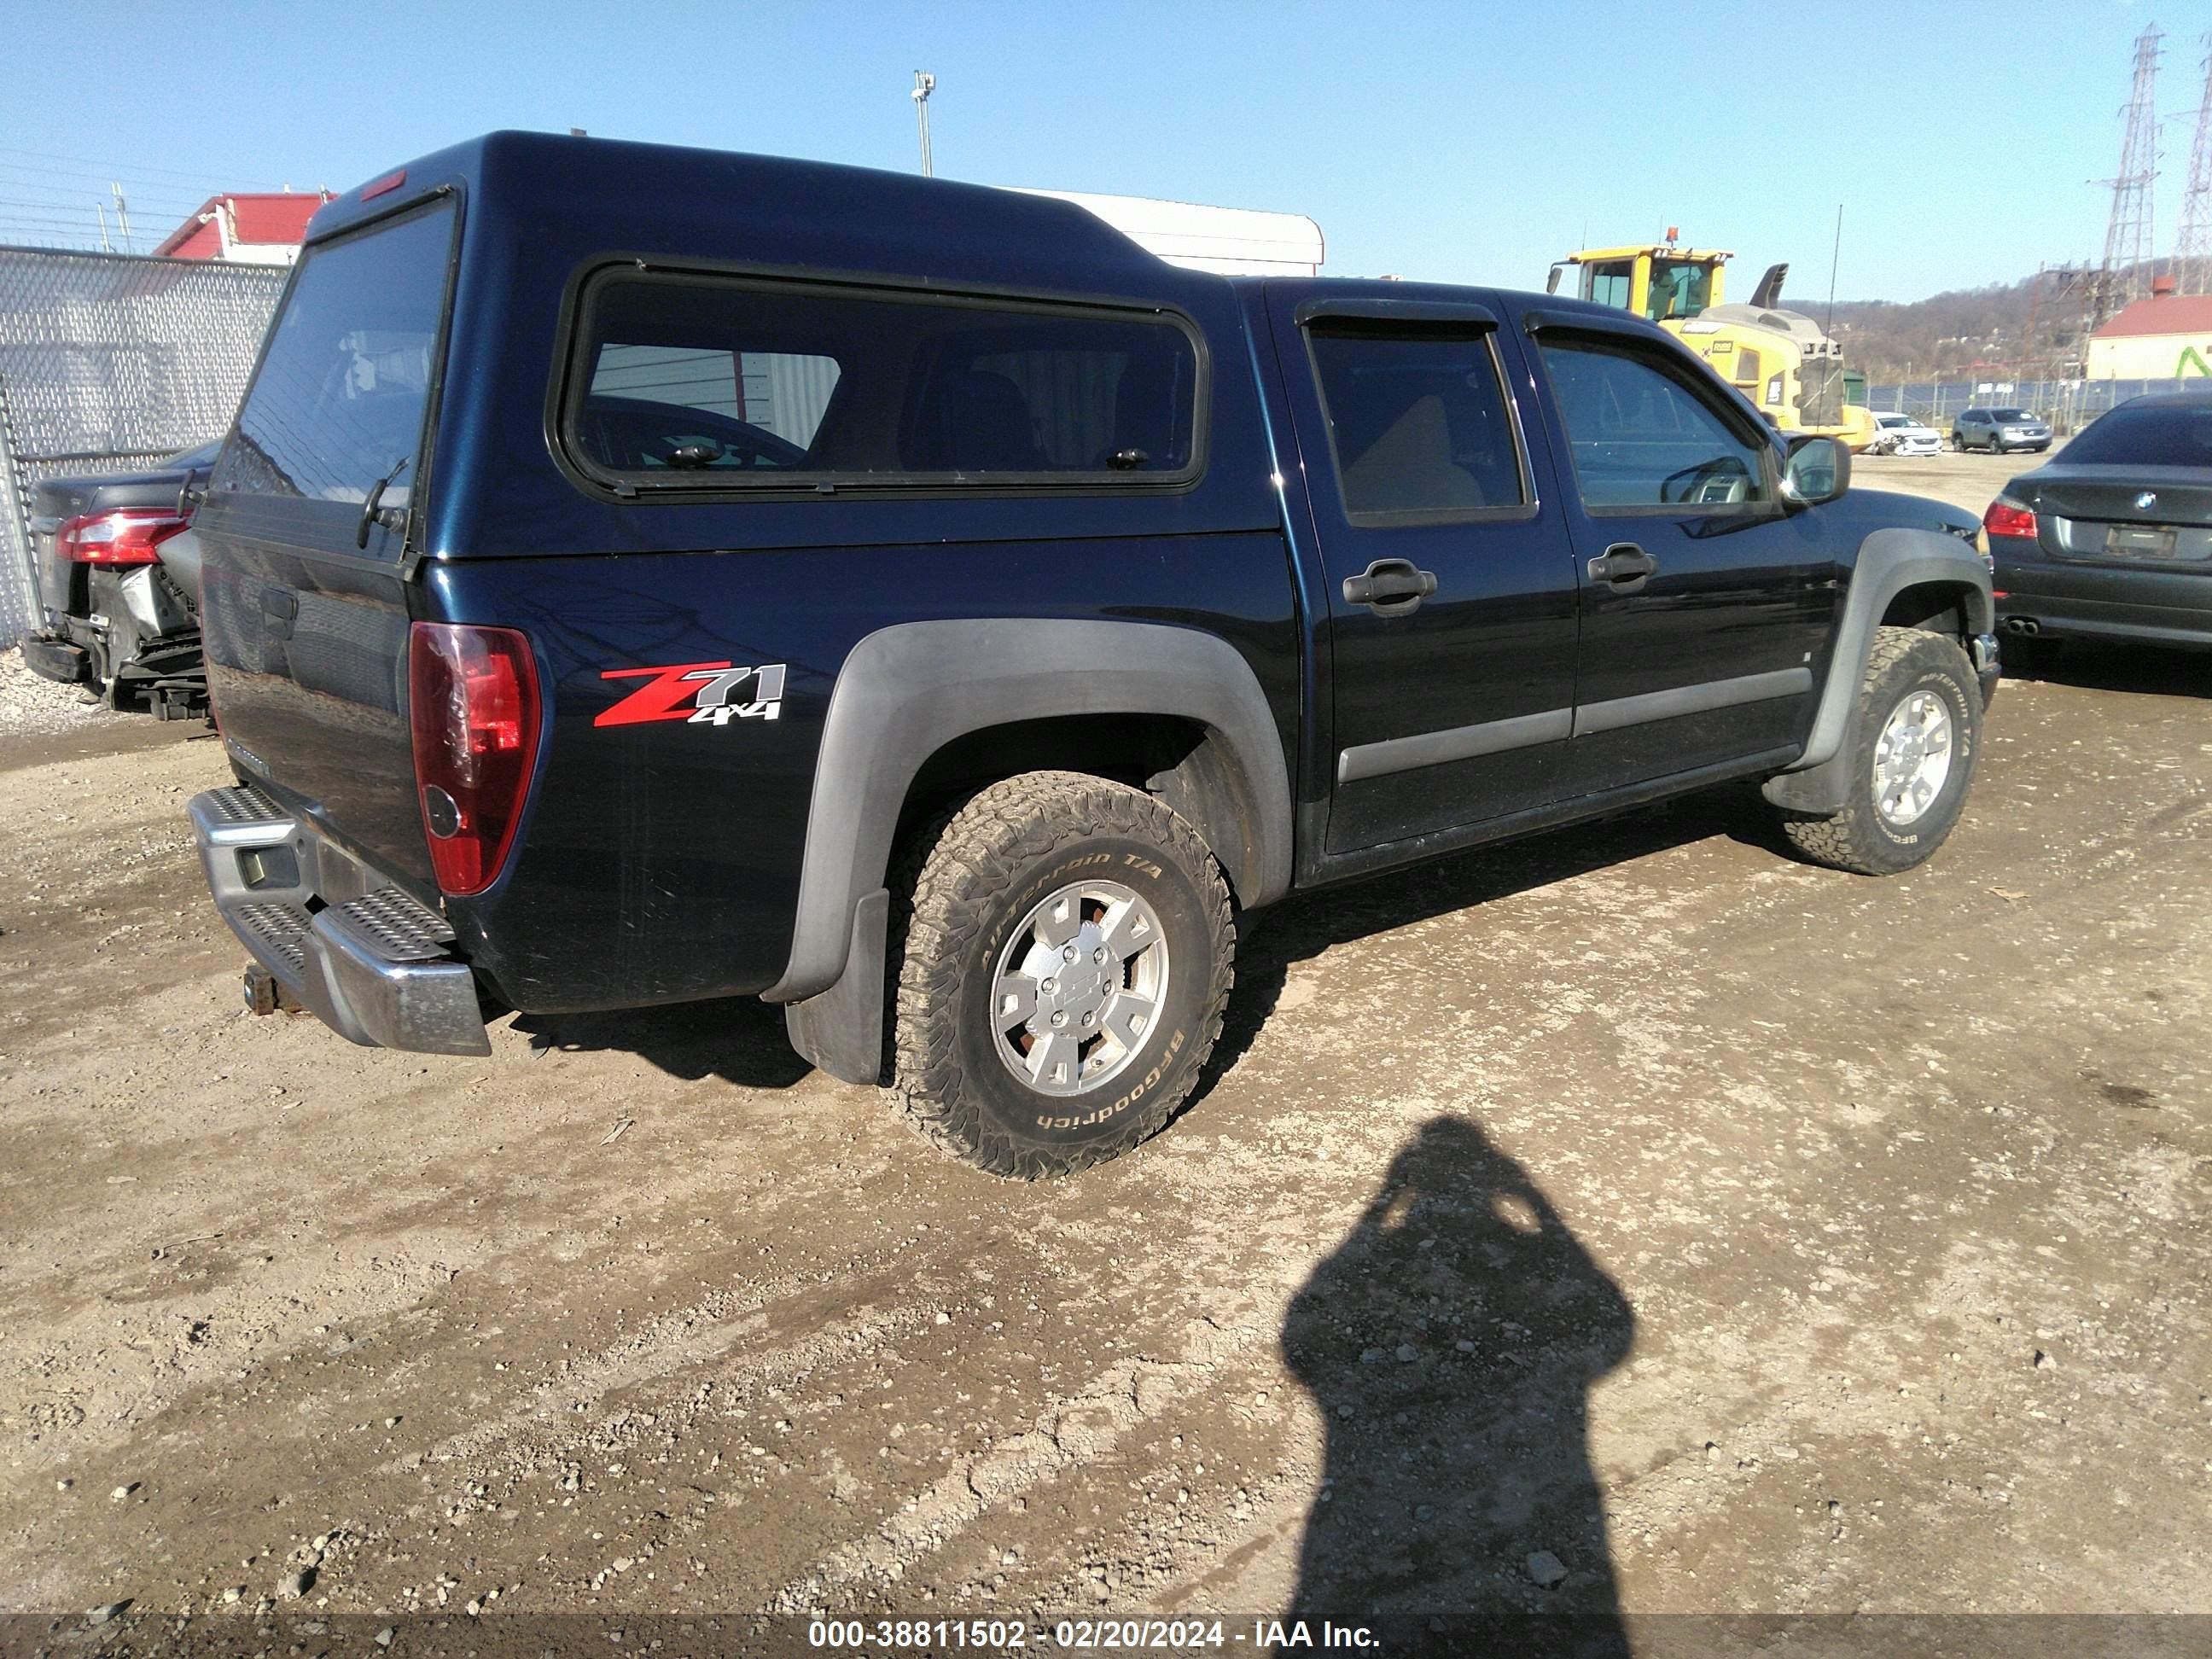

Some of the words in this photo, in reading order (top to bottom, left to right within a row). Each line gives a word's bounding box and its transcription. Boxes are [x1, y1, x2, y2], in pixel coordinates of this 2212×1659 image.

[594, 661, 784, 727] Z71
[687, 701, 781, 726] 4x4
[1124, 853, 1163, 880] T/A
[1037, 1028, 1185, 1130] BFGoodrich
